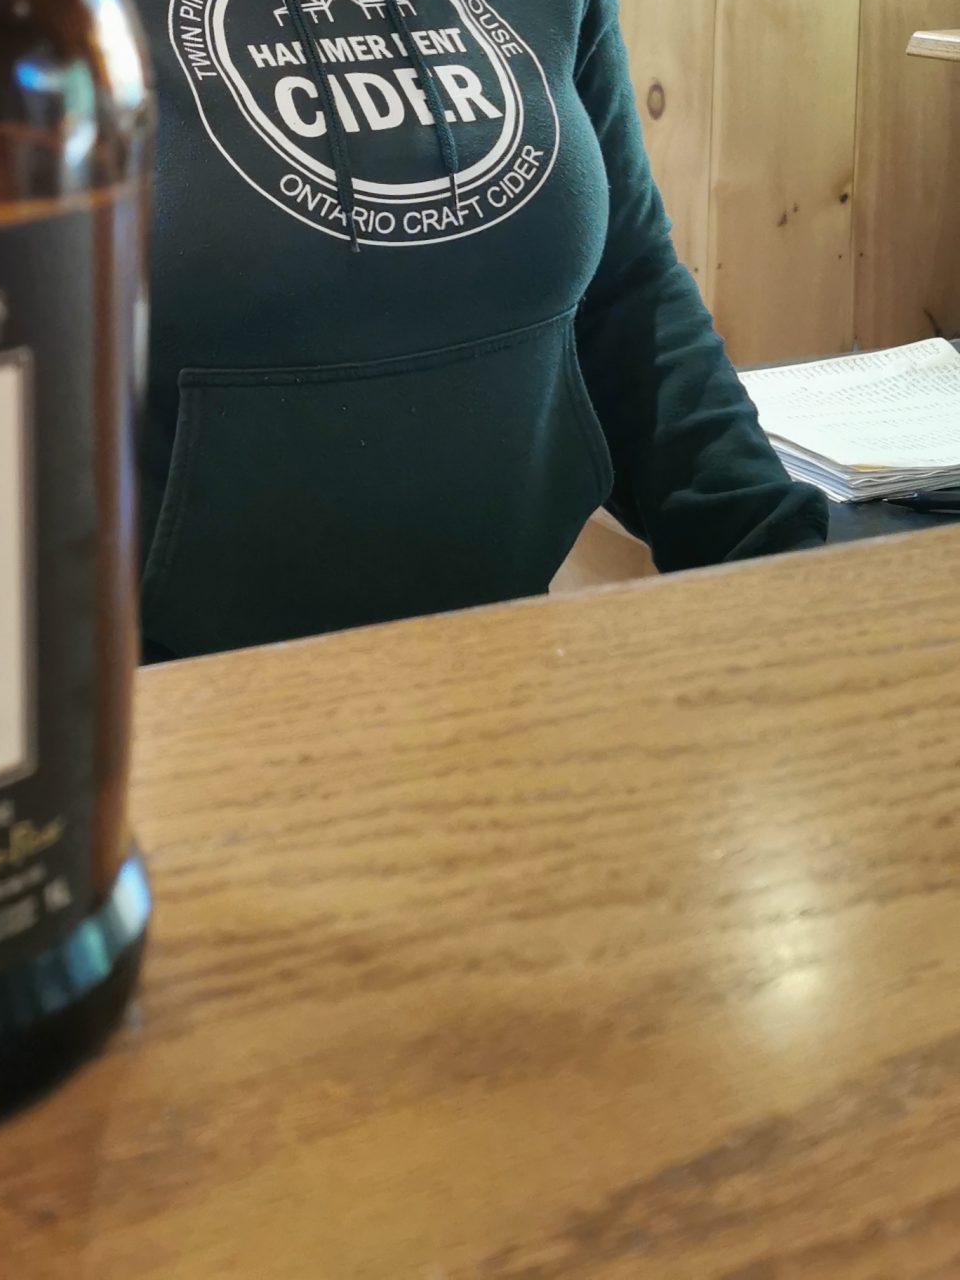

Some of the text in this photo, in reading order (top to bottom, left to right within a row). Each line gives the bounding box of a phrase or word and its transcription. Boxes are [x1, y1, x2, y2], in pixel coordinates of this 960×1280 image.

[179, 25, 218, 81] TWIN
[274, 64, 504, 138] CIDER
[279, 144, 545, 235] ONTARIO CRAFT CIDER
